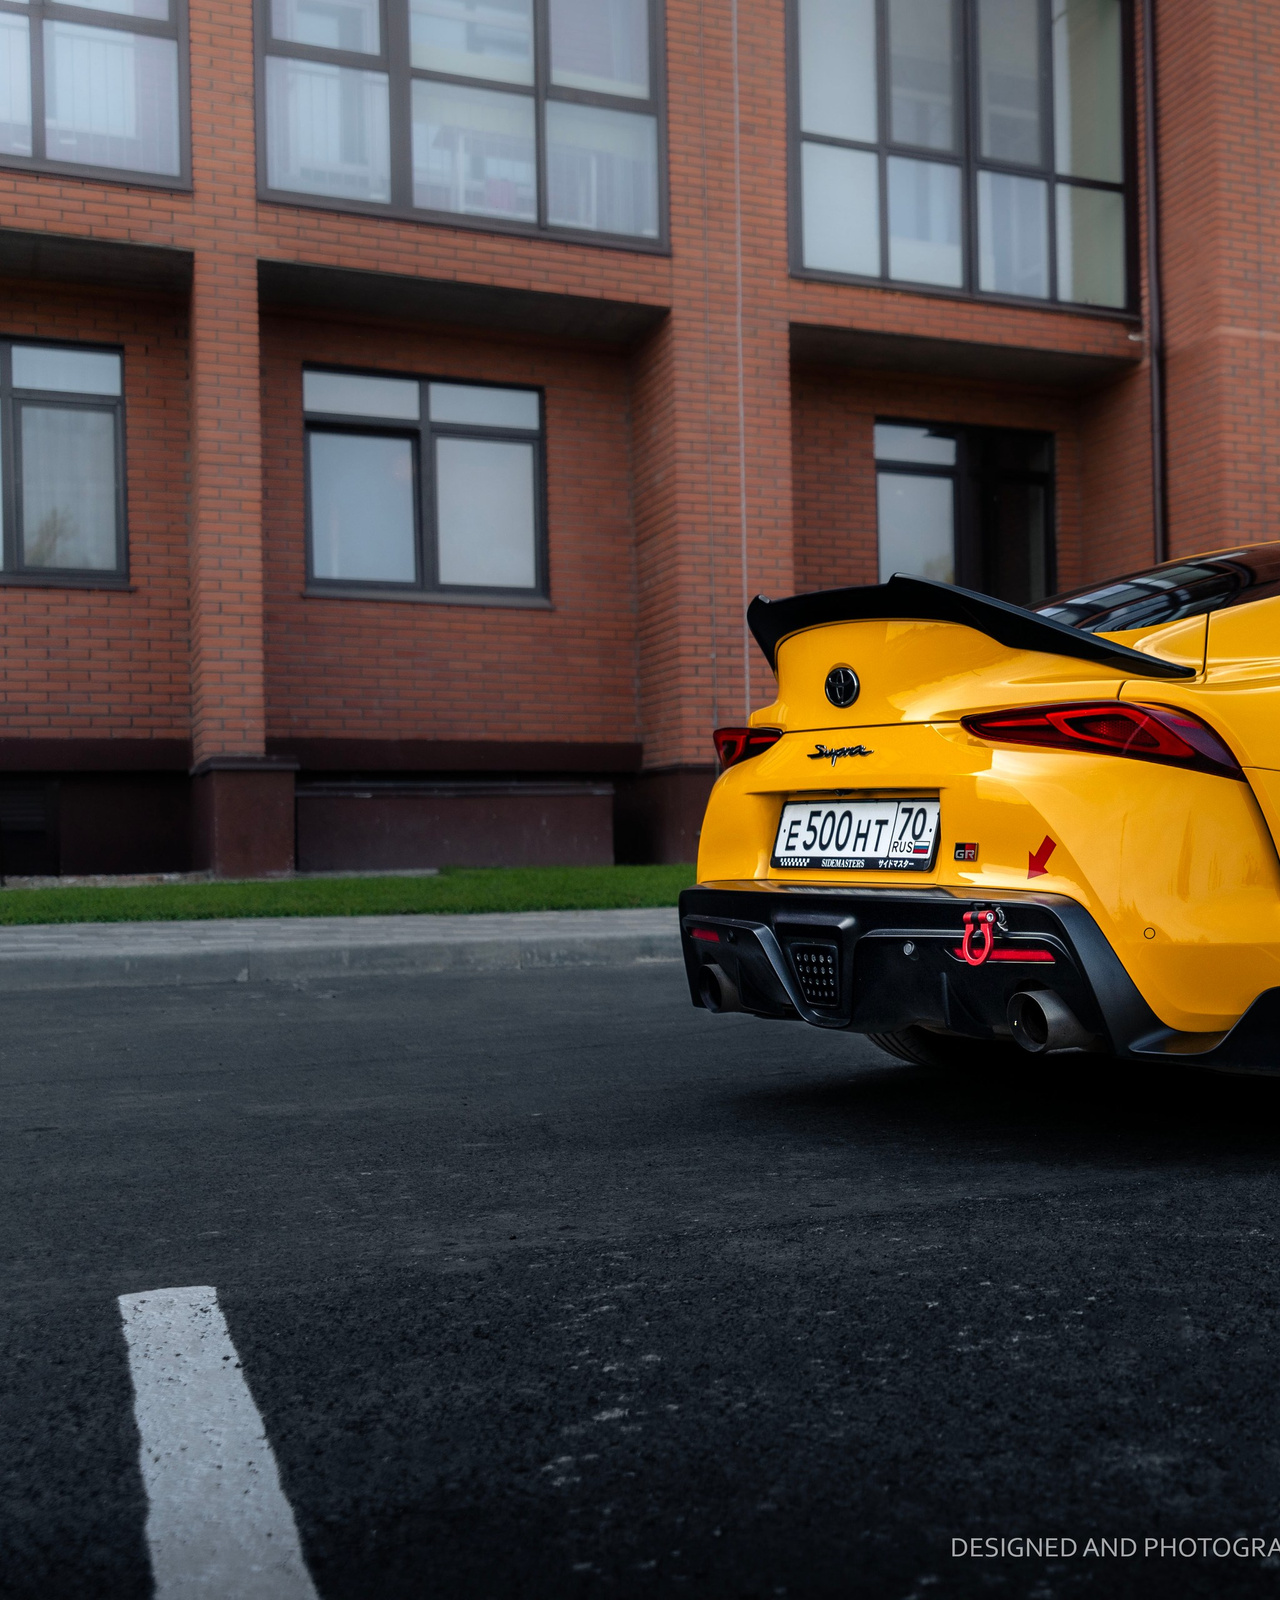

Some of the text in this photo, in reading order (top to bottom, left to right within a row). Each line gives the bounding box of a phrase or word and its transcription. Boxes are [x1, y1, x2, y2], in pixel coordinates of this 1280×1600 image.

[807, 744, 874, 767] Supra
[898, 807, 927, 841] 70
[891, 841, 913, 853] RUS
[955, 849, 975, 859] GR
[821, 858, 866, 868] SIDEMASTERS
[878, 859, 914, 868] サイドマスター
